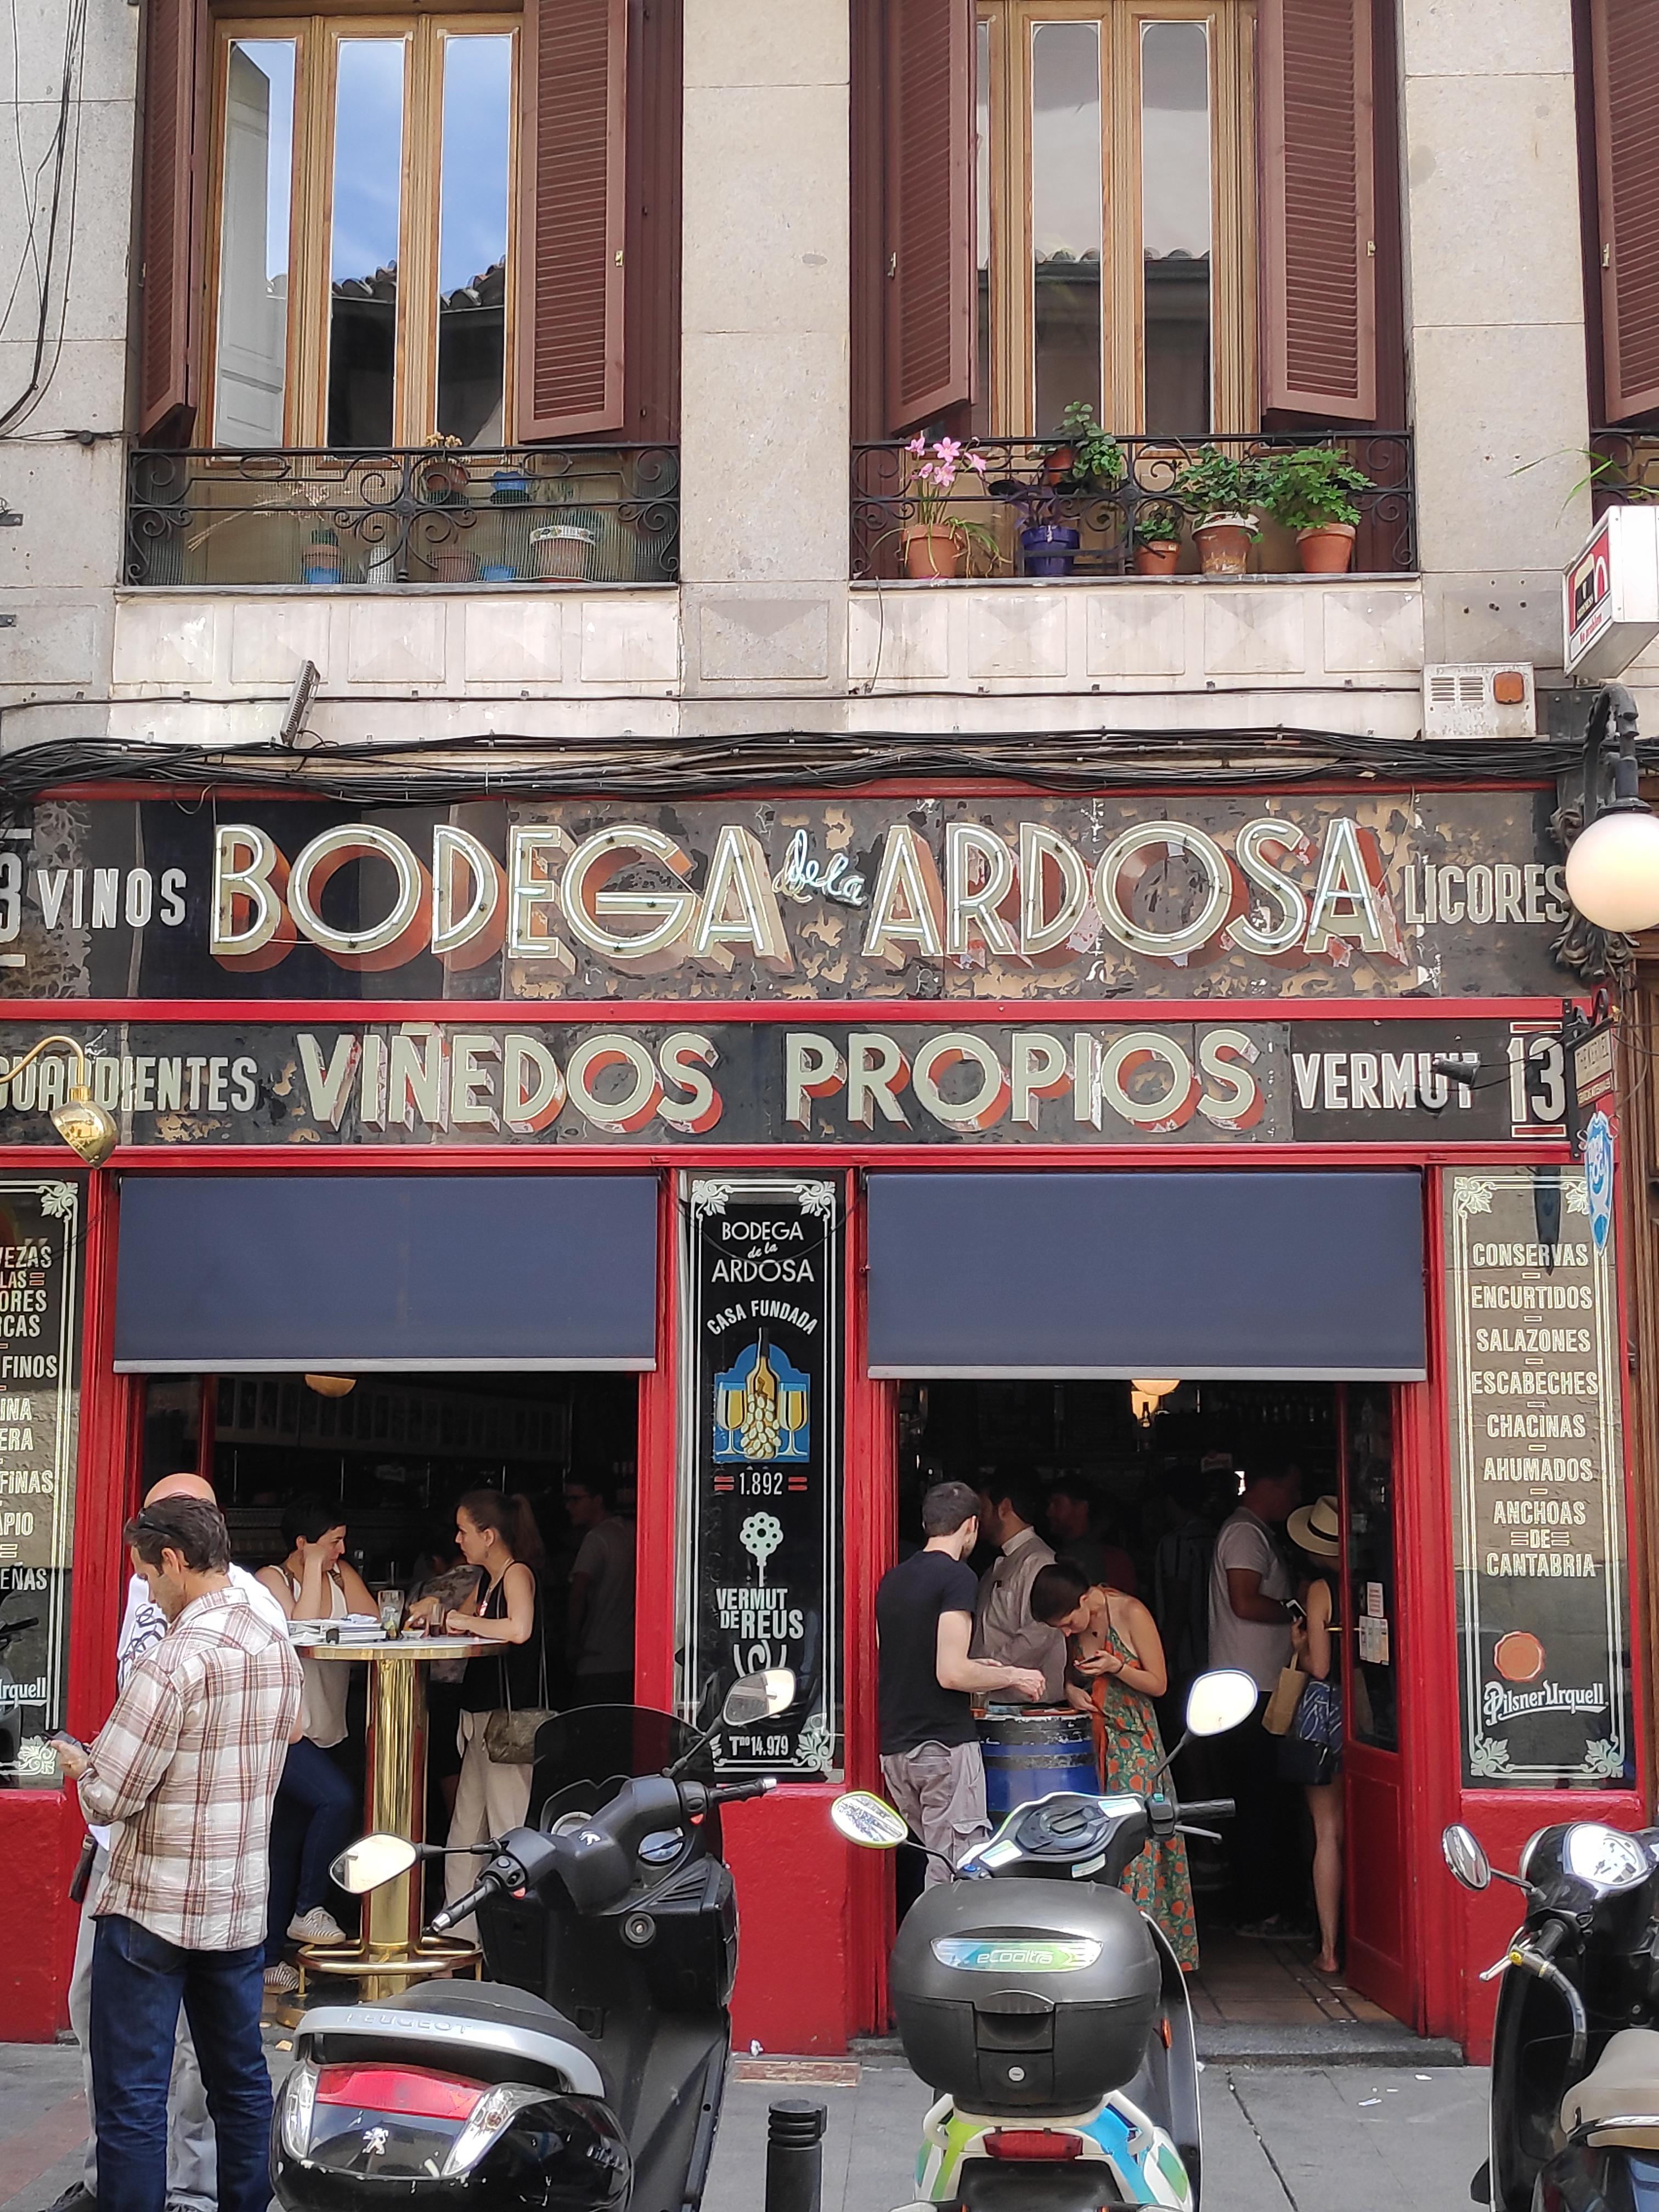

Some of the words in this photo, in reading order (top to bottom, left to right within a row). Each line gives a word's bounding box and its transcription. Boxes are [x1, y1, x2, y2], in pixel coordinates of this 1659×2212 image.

[36, 867, 187, 930] VINOS
[210, 824, 786, 960] BODEGA
[861, 818, 1389, 958] ARDOSA
[1404, 864, 1570, 924] LICORES
[297, 1022, 720, 1125] VIÑEDOS
[786, 1029, 1261, 1125] PROPIOS
[1506, 1037, 1566, 1122] 13
[722, 1221, 805, 1240] BODEGA
[747, 1245, 763, 1259] de
[764, 1241, 778, 1255] la
[1472, 1243, 1589, 1267] CONSERVAS
[711, 1259, 815, 1283] ARDOSA
[1471, 1285, 1593, 1310] ENCURTIDOS
[0, 1314, 41, 1338] CAS
[707, 1304, 747, 1335] CASA
[751, 1299, 819, 1335] FUNDADA
[1476, 1328, 1591, 1352] SALAZONES
[2, 1355, 58, 1379] FINOS
[1471, 1371, 1599, 1395] ESCABECHES
[1486, 1414, 1586, 1437] CHACINAS
[1483, 1457, 1593, 1481] AHUMADOS
[0, 1470, 54, 1494] FINAS
[739, 1472, 783, 1496] 1.892
[1493, 1500, 1587, 1525] ANCHOAS
[1530, 1529, 1551, 1549] DE
[1486, 1553, 1597, 1577] CANTABRIA
[716, 1588, 788, 1610] VERMUT
[720, 1610, 740, 1629] DE
[741, 1609, 804, 1639] REUS
[1483, 1680, 1546, 1726] Pilsner
[1543, 1679, 1605, 1714] Urquell
